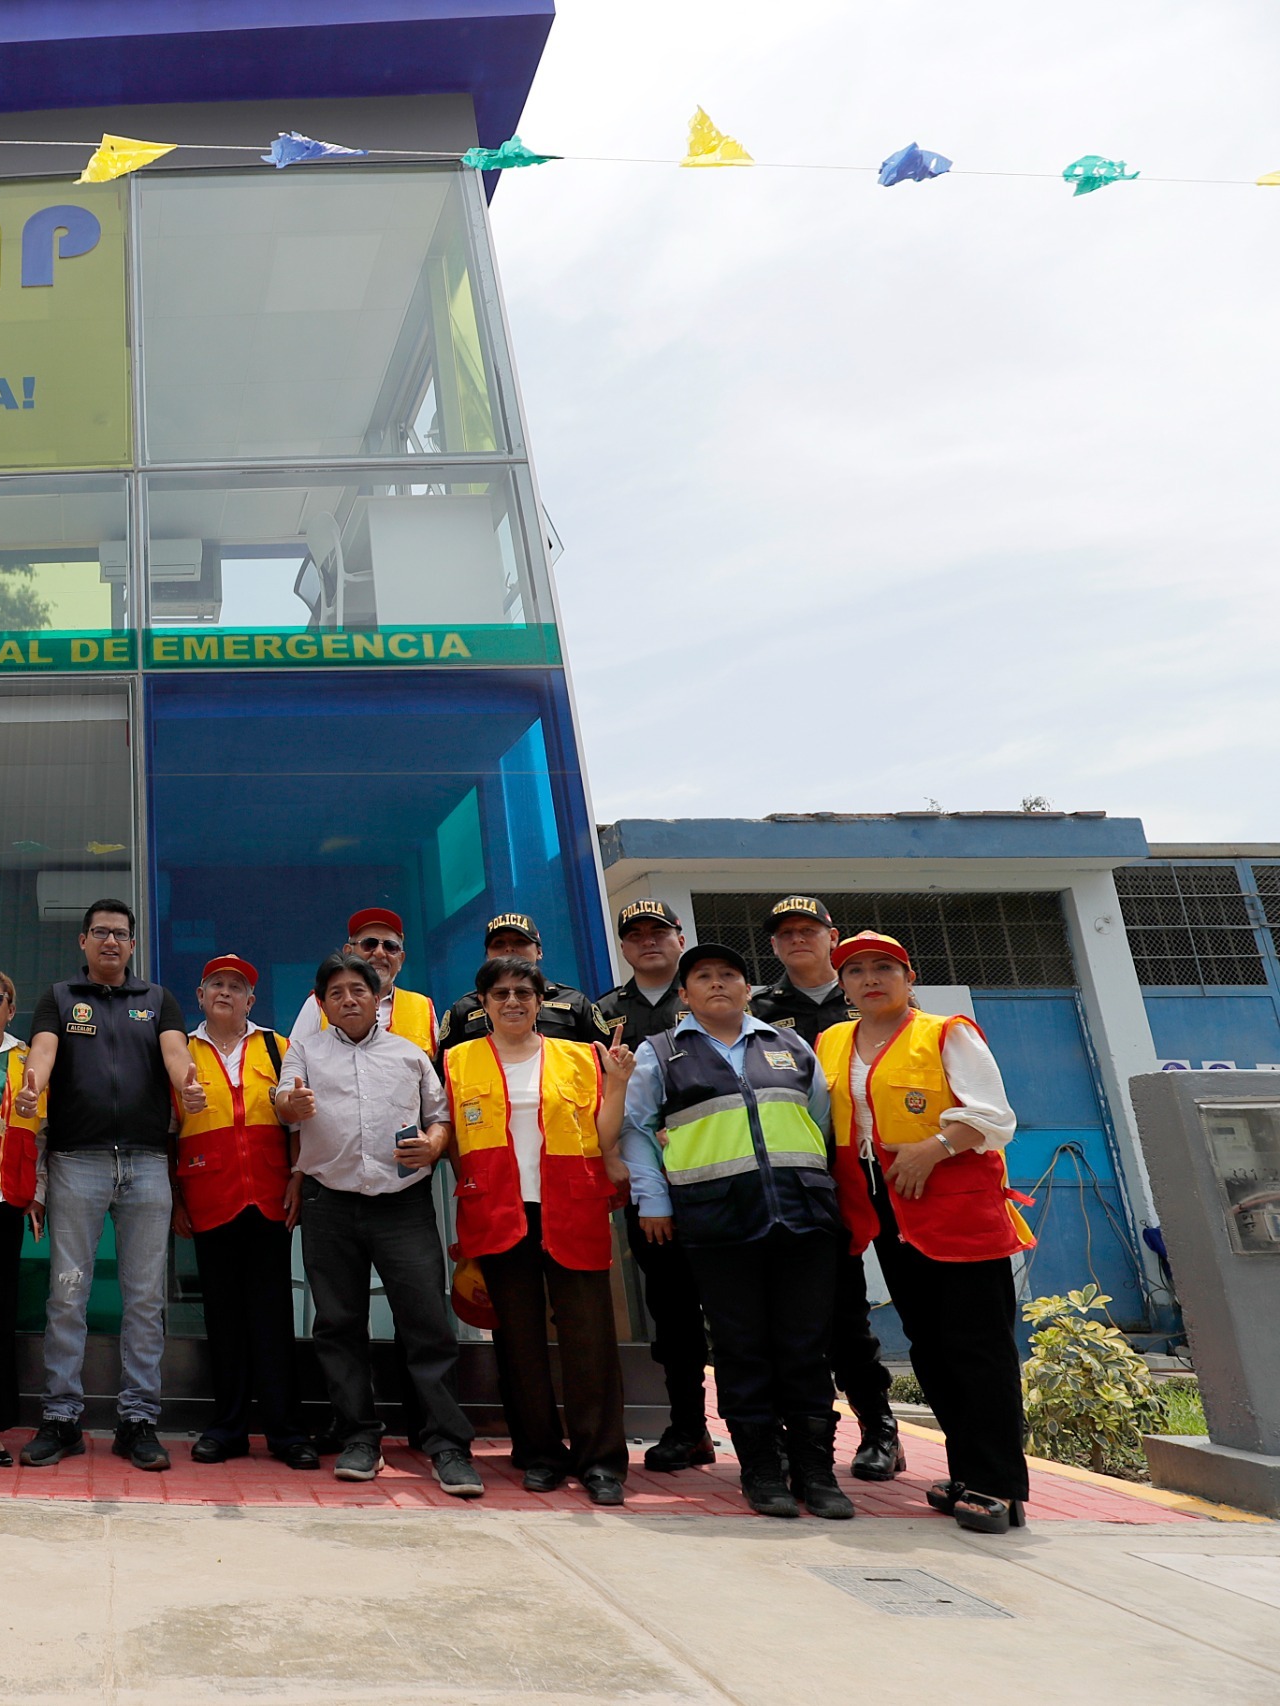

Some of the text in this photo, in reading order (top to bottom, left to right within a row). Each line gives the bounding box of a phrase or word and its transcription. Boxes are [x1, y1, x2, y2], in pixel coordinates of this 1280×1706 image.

[70, 637, 130, 663] DE
[152, 632, 472, 661] EMERGENCIA
[621, 900, 666, 923] POLICIA
[487, 913, 530, 932] POLICIA
[70, 1025, 93, 1033] ALCALDE
